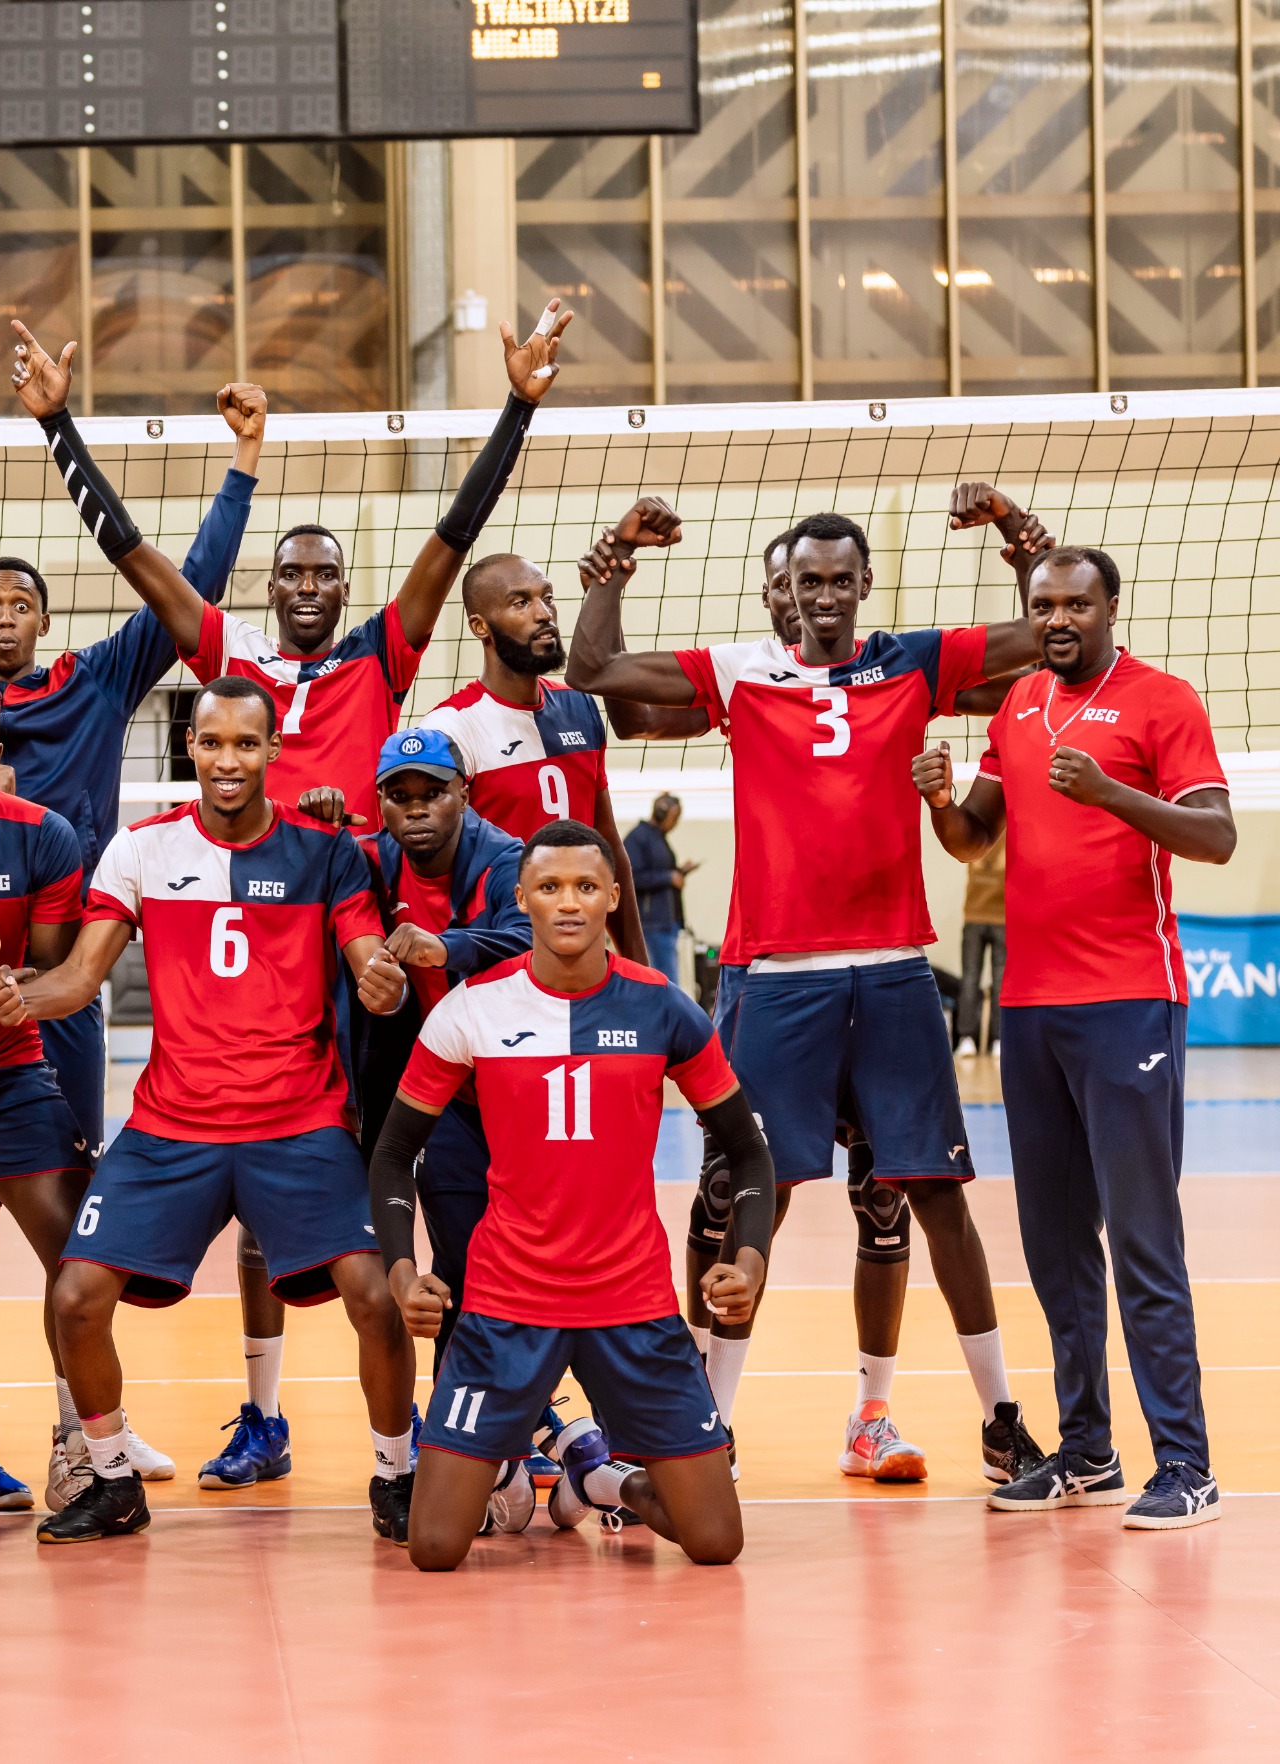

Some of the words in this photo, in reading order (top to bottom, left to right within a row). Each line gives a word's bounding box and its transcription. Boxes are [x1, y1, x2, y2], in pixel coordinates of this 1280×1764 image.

[850, 665, 885, 686] REG
[812, 686, 851, 757] 3
[1081, 707, 1121, 724] REG
[558, 731, 587, 746] REG
[538, 764, 570, 820] 9
[247, 879, 286, 898] REG
[209, 906, 250, 978] 6
[1184, 961, 1280, 999] YAN
[597, 1030, 638, 1048] REG
[541, 1060, 595, 1141] 11
[76, 1195, 103, 1236] 6
[443, 1385, 487, 1434] 11
